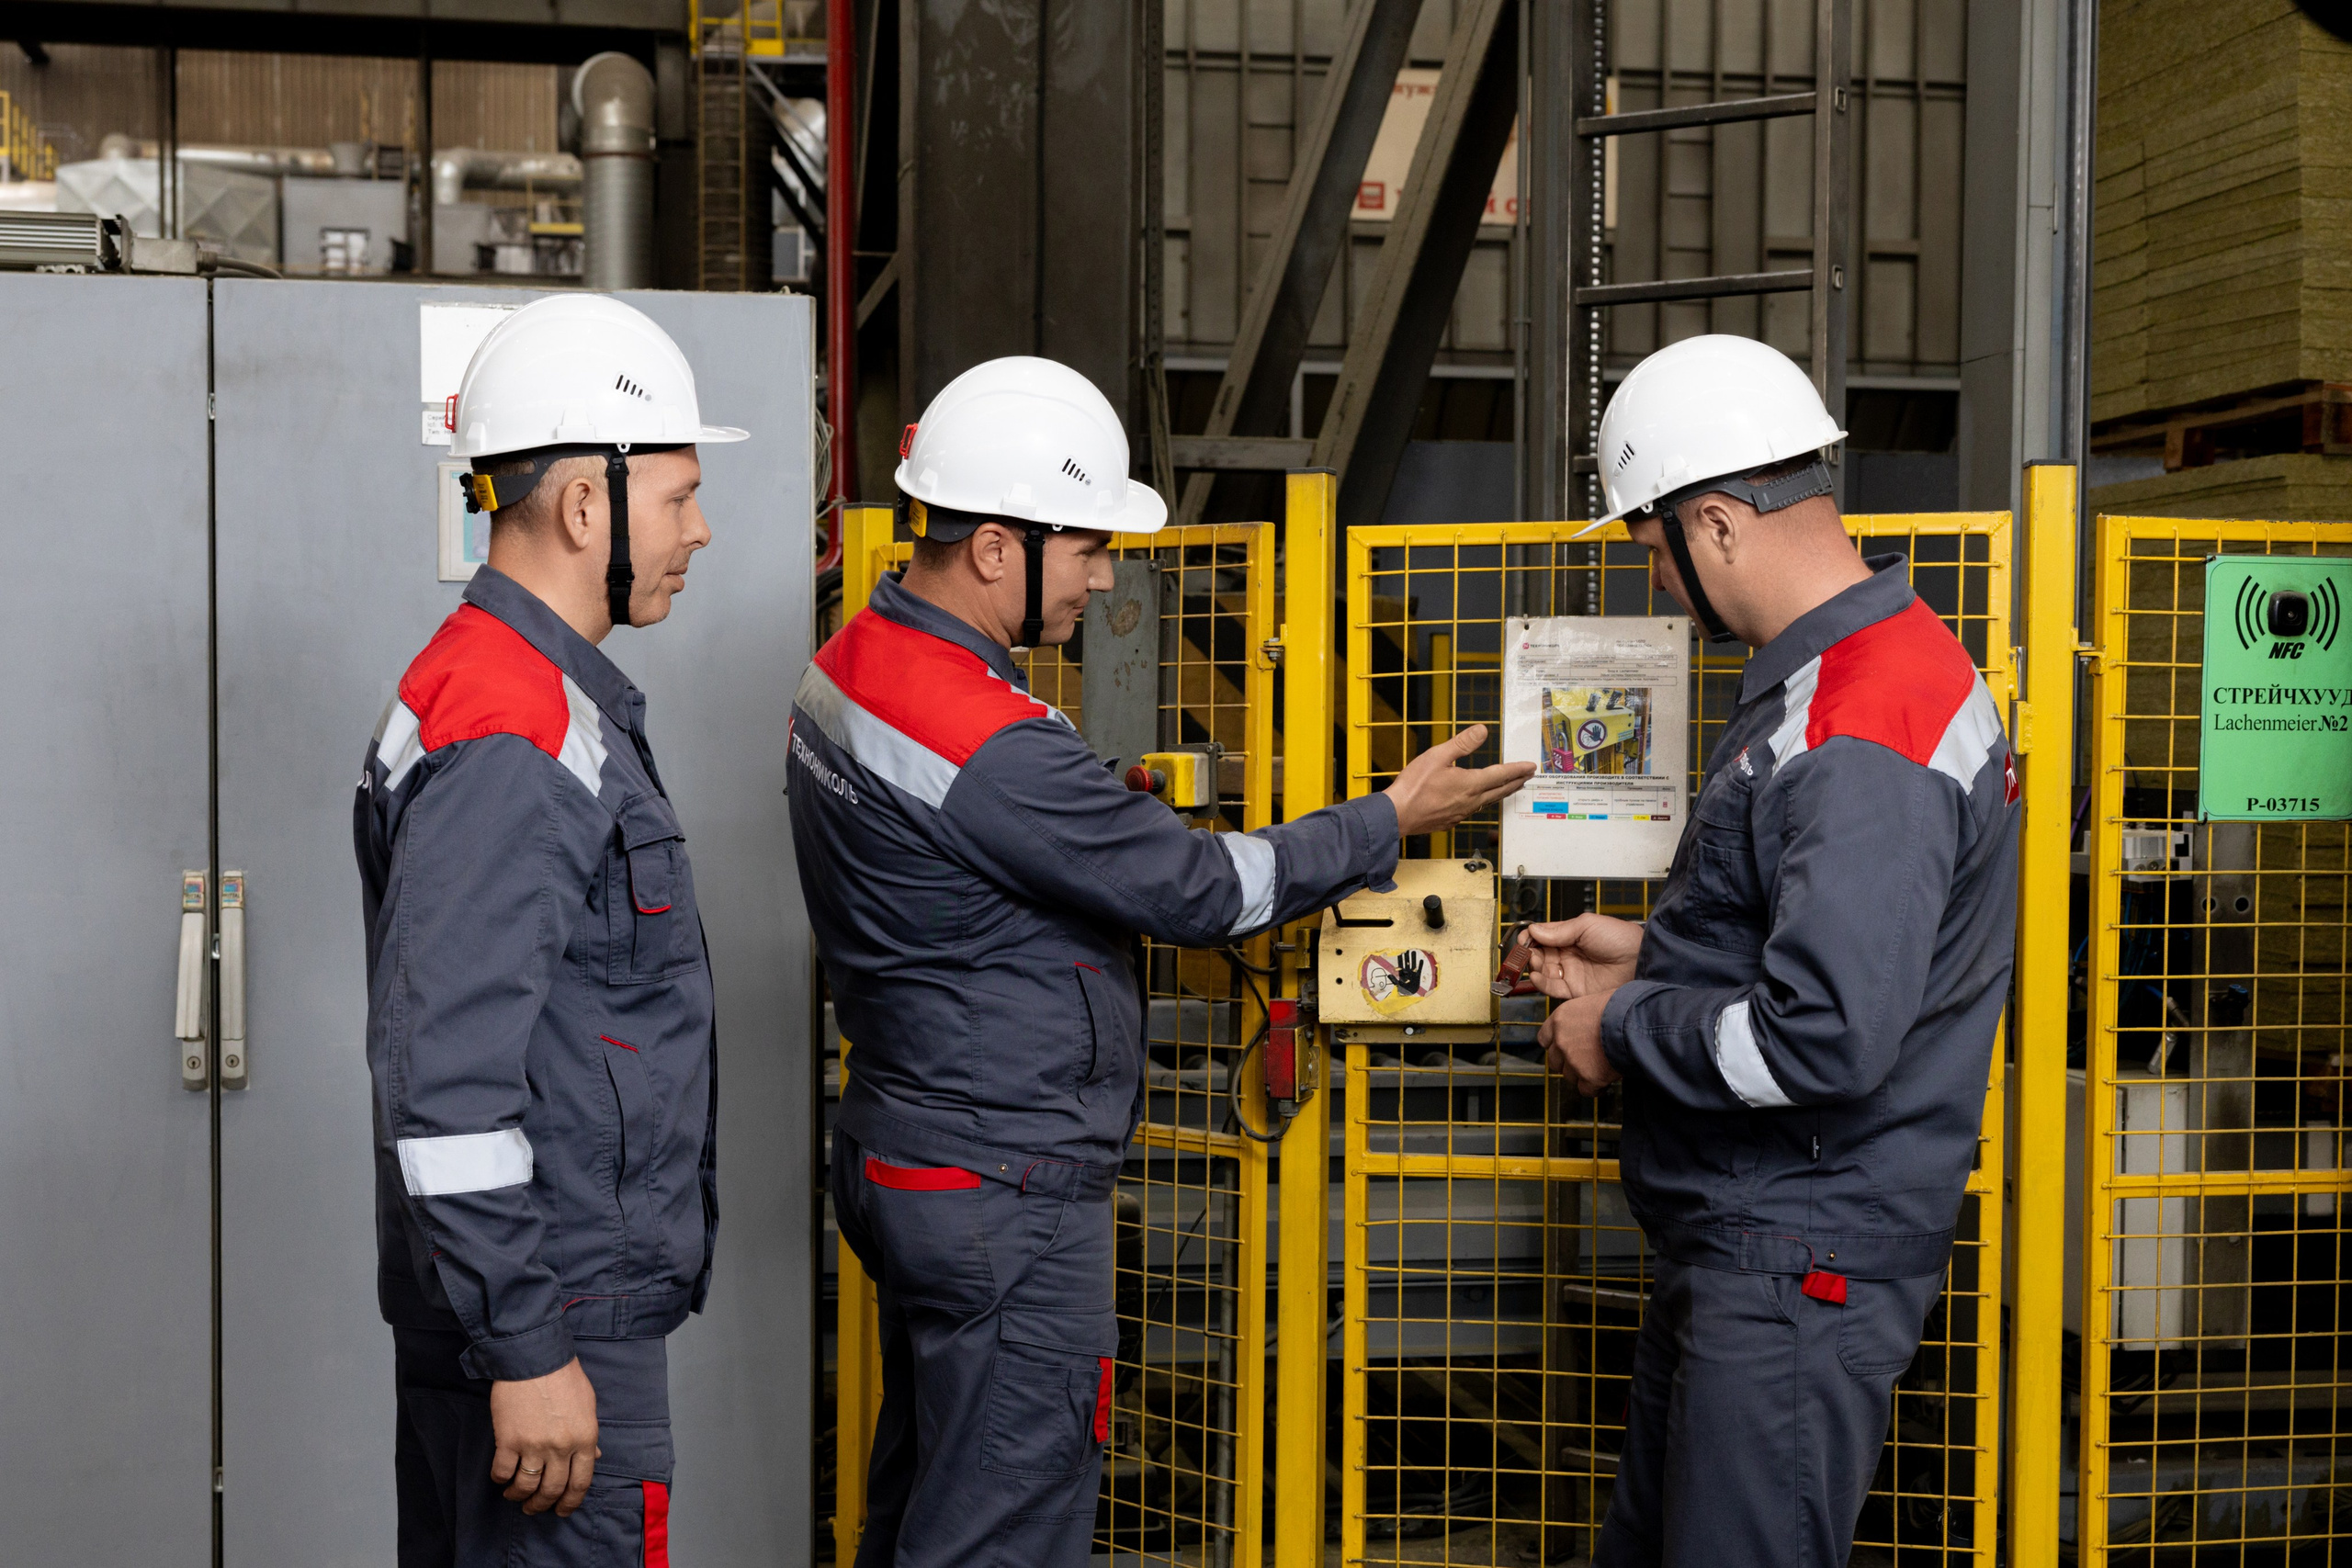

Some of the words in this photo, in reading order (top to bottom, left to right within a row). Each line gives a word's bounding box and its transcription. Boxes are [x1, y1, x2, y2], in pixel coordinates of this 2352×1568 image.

[2268, 642, 2305, 659] NFC
[2213, 683, 2352, 708] СТРЕЙЧХУУД
[792, 732, 858, 805] ТЕХНОНИКОЛЬ
